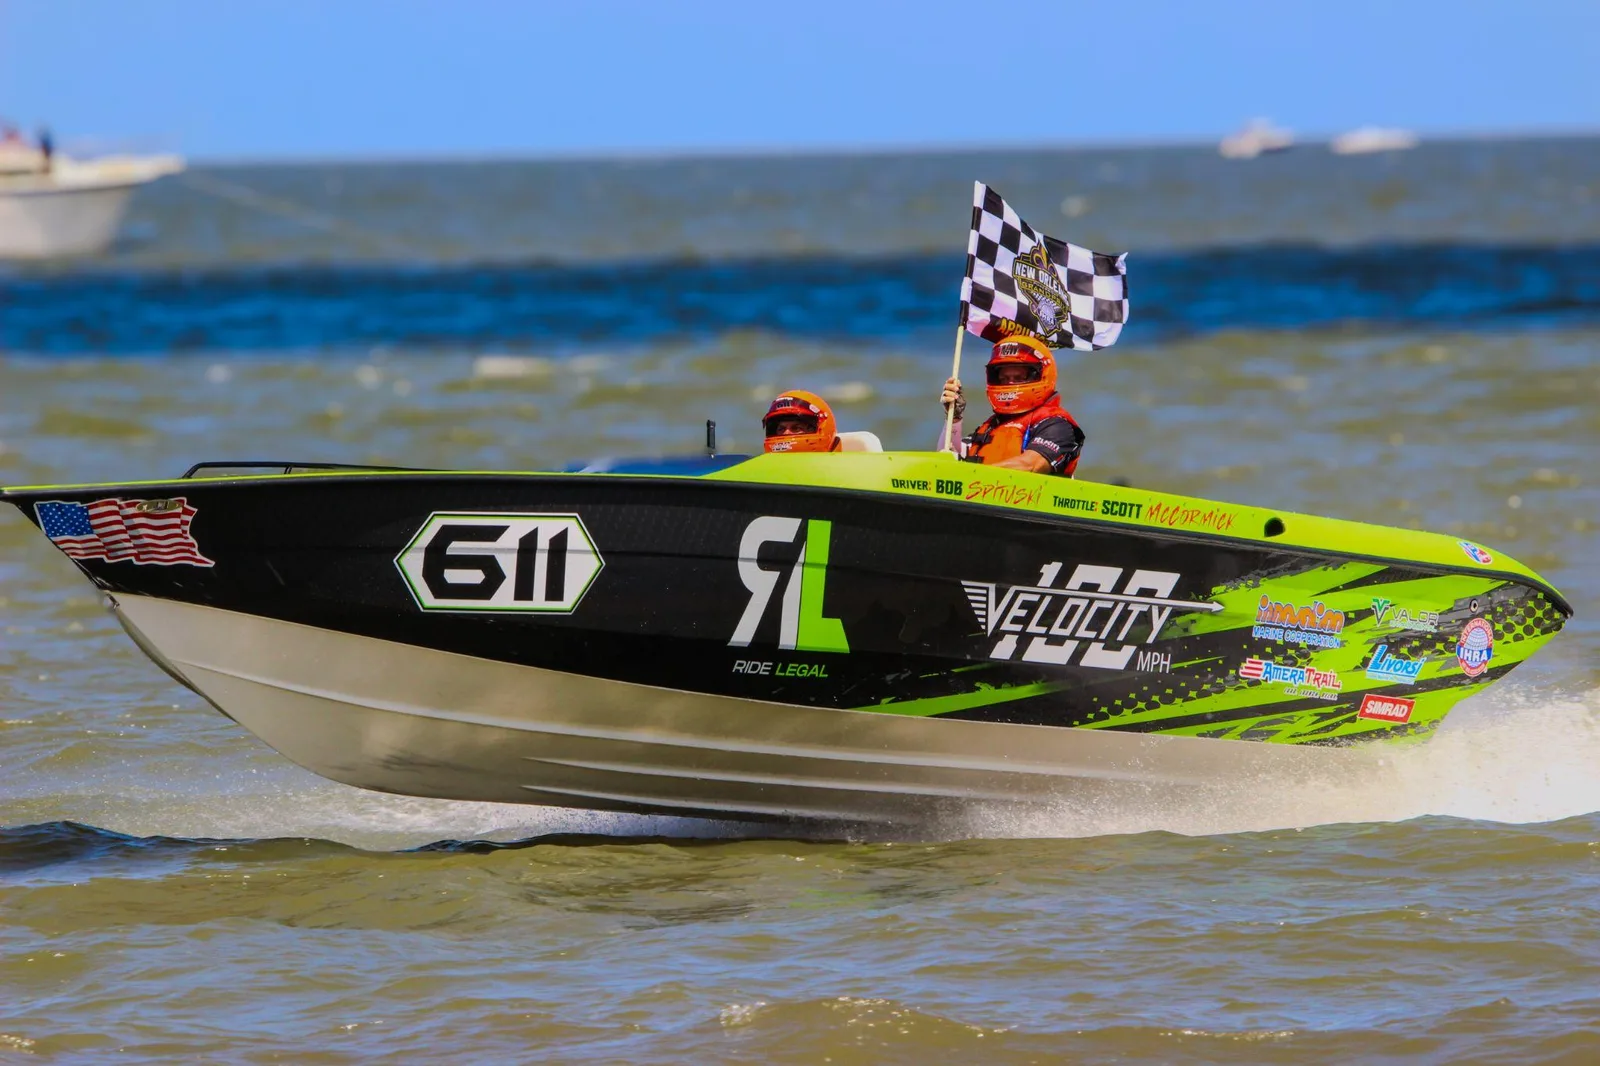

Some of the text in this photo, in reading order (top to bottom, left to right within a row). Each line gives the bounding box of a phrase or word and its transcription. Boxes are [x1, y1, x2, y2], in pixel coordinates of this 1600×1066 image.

[1015, 262, 1035, 279] NEW
[890, 478, 932, 492] DRIVER:
[935, 479, 963, 496] BOB
[1052, 495, 1099, 514] THROTTLE:
[1101, 500, 1143, 520] SCOTT
[421, 524, 569, 602] 611
[960, 580, 1173, 643] VELOCITY
[1392, 607, 1439, 626] VALOR
[1252, 625, 1284, 641] MARINE
[1136, 650, 1172, 674] MPH
[1459, 647, 1488, 662] IHRA
[732, 660, 829, 679] RIDE LEGAL
[1365, 700, 1408, 718] SIMRAD
